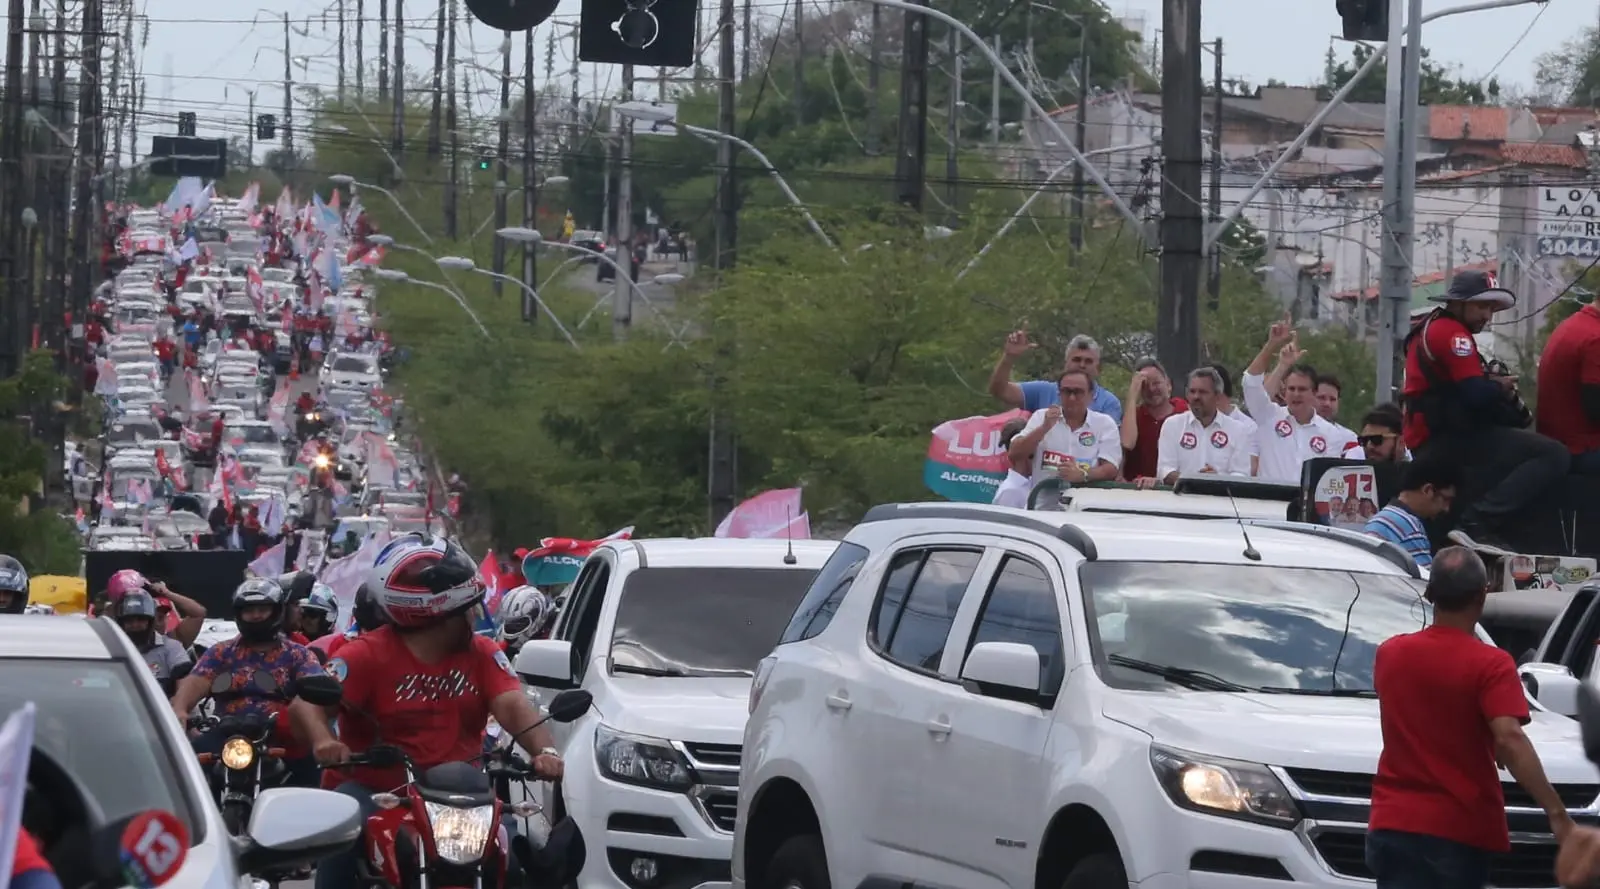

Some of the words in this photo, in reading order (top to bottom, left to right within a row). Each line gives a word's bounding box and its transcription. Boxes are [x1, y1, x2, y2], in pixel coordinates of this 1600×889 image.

[1454, 337, 1470, 350] 13
[1278, 422, 1291, 434] 13
[1184, 435, 1195, 445] 13
[1214, 432, 1227, 444] 13
[135, 817, 180, 876] 13
